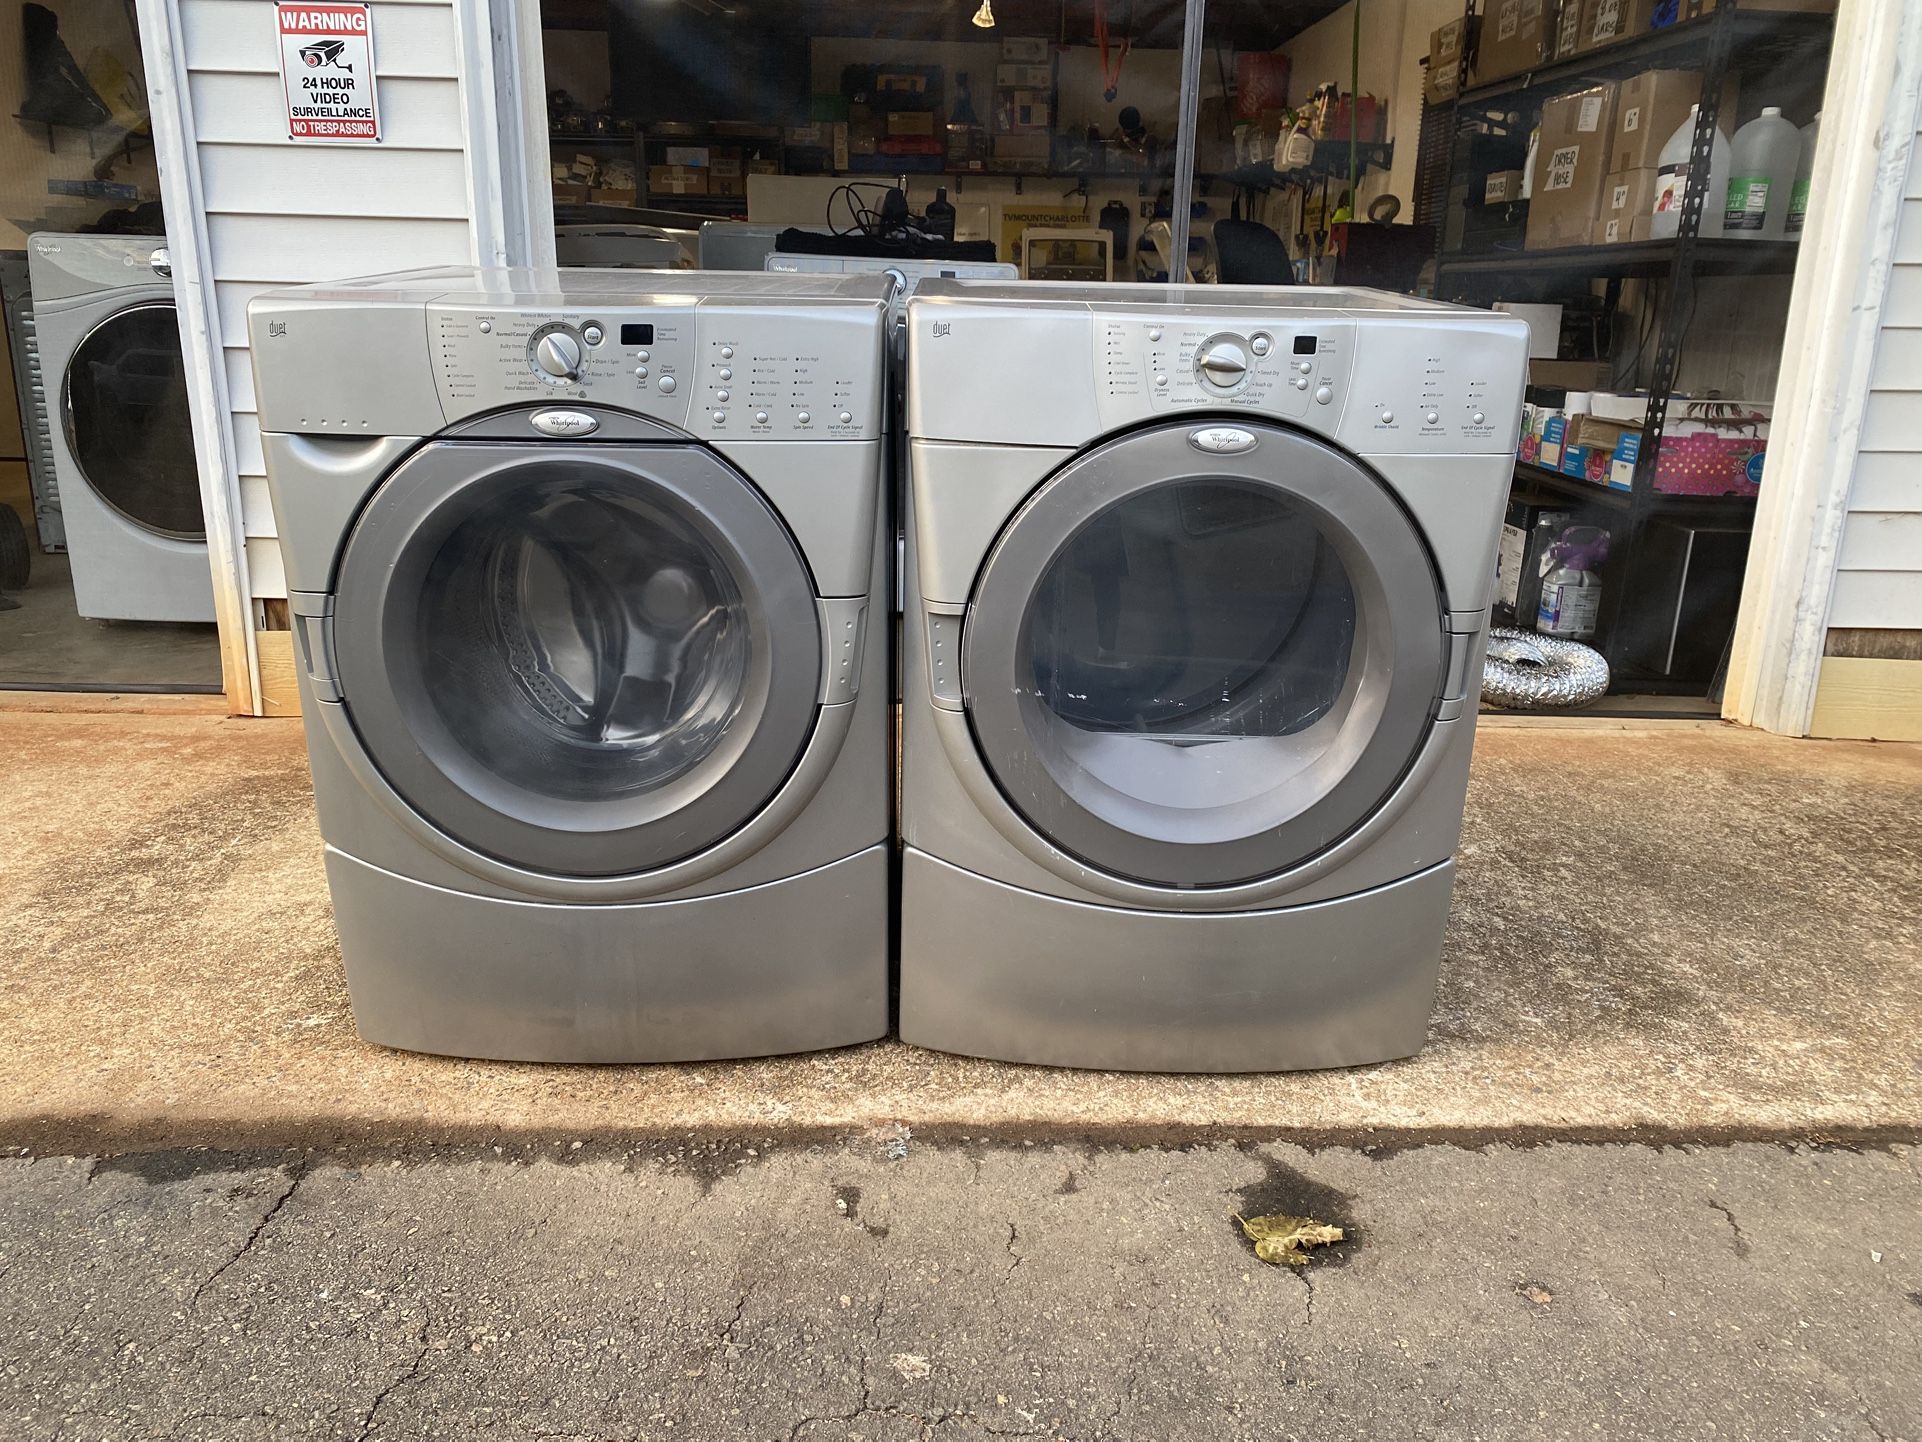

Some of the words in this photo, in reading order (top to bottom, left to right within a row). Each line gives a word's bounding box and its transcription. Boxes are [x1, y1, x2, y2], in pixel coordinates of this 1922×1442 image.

[281, 11, 366, 31] WARNING
[302, 77, 317, 89] 24
[321, 77, 355, 90] HOUR
[310, 92, 350, 105] VIDEO
[292, 106, 372, 118] SURVEILLANCE
[293, 121, 307, 134] NO
[308, 121, 374, 136] TRESPASSING
[1554, 151, 1576, 168] DRYER
[1553, 171, 1570, 187] HOSE
[1003, 213, 1091, 223] TVMOUNTCHARLOTTE
[269, 320, 287, 337] duet
[932, 320, 951, 338] duet
[550, 417, 580, 429] Whirlpool
[1211, 434, 1240, 446] Whirlpool
